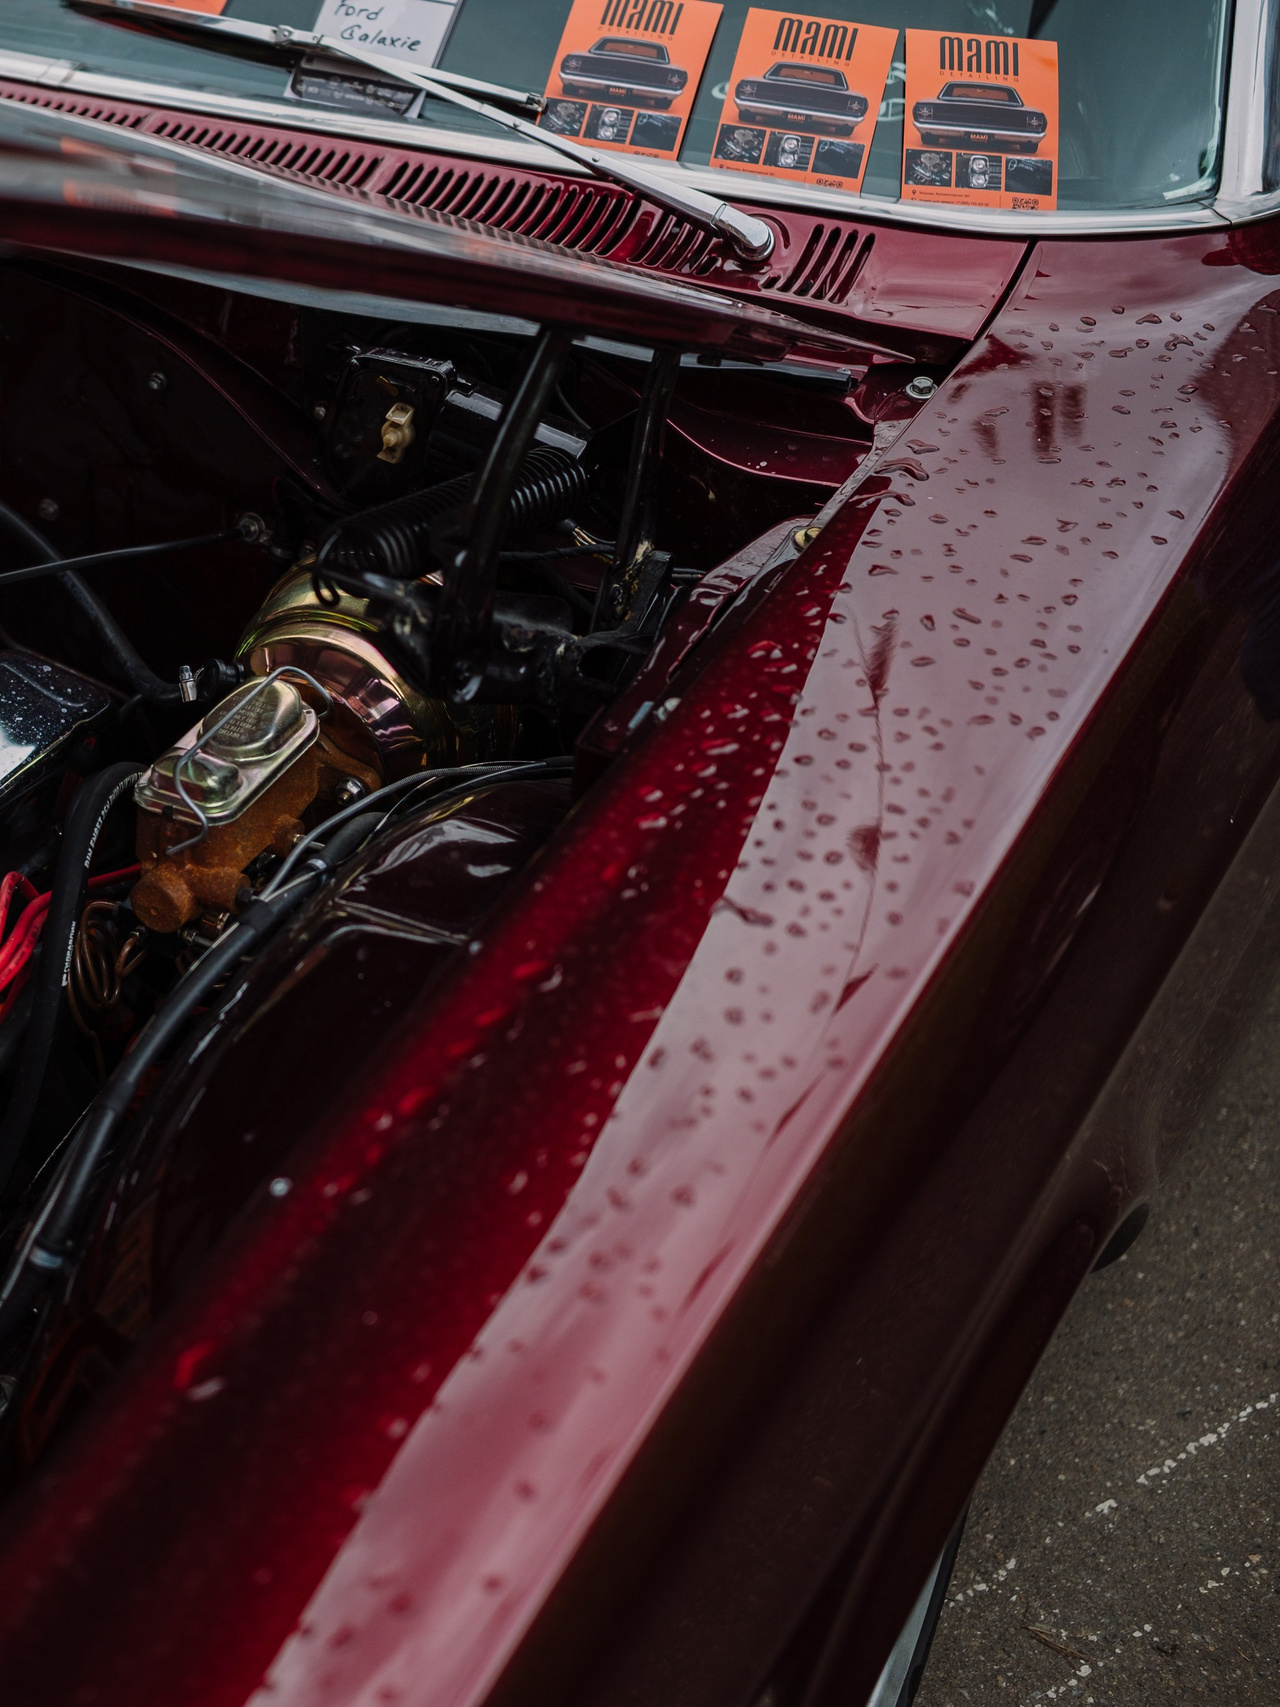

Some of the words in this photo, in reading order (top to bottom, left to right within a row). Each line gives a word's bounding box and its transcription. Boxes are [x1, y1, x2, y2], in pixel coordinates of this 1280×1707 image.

[340, 24, 422, 52] Galaxie
[597, 25, 675, 41] DETAILING
[770, 51, 851, 67] DETAILING
[939, 71, 1019, 82] DETAILING
